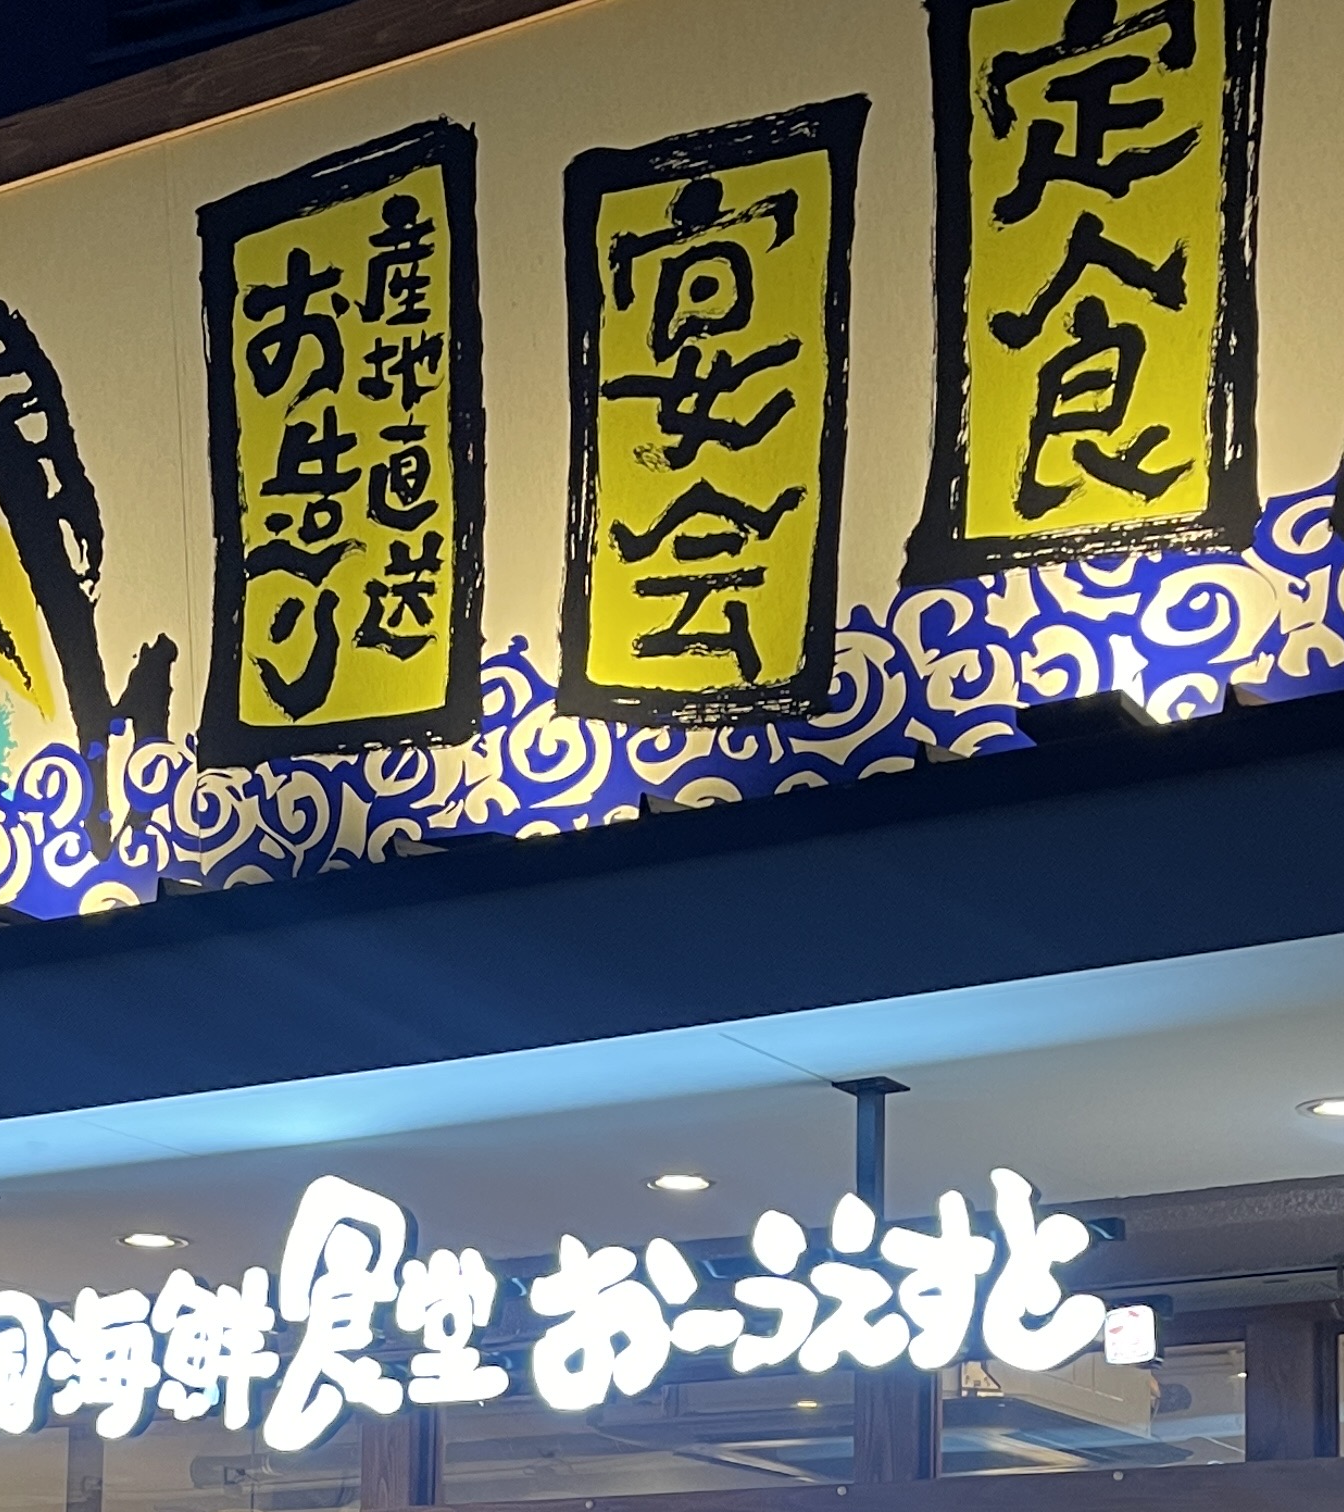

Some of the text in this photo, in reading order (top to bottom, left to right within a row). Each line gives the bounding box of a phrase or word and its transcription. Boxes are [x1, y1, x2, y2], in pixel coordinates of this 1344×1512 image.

[242, 247, 367, 723] お造り
[354, 193, 446, 663] 産地直送
[602, 175, 808, 686] 宴会
[979, 0, 1202, 520] 定食
